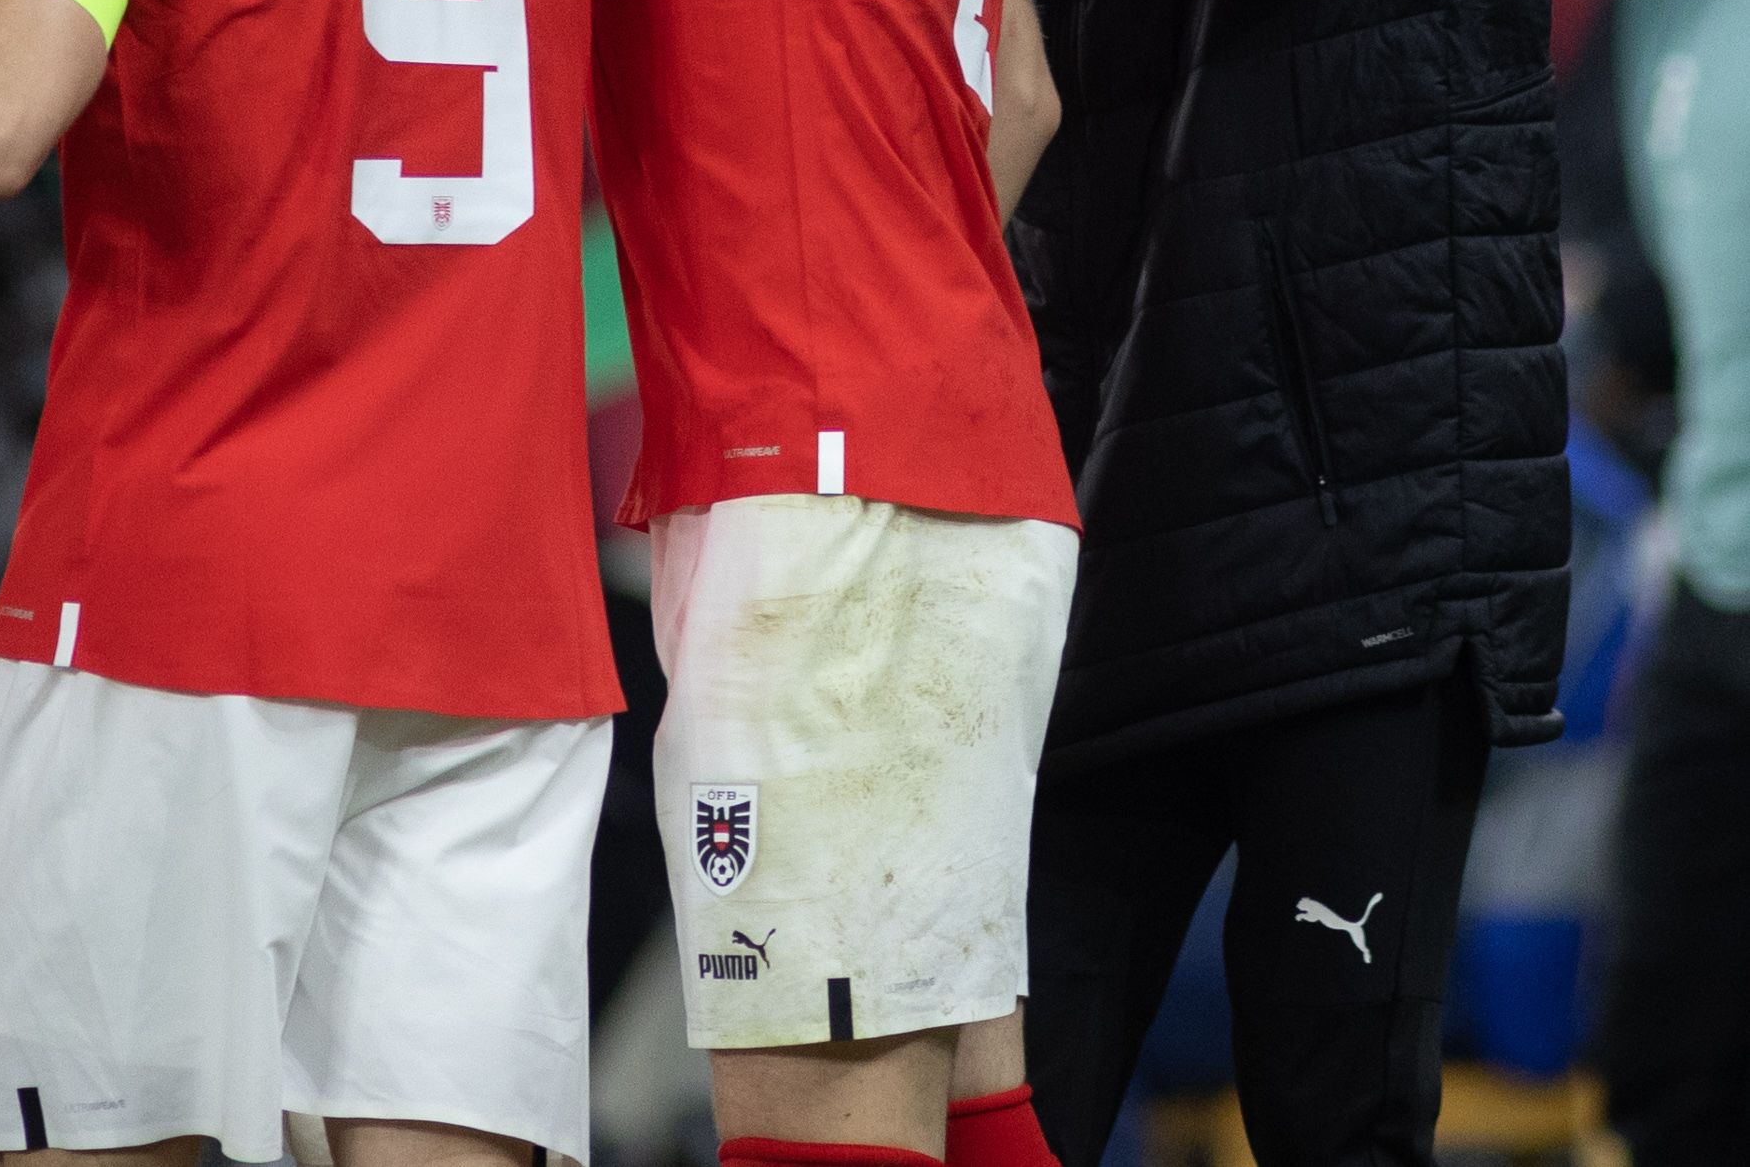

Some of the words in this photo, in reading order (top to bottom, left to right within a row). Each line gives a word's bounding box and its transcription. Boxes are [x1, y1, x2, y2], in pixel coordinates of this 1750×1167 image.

[1360, 626, 1414, 648] WARMCELL
[707, 788, 737, 801] ÖFB
[697, 953, 758, 981] PUMA
